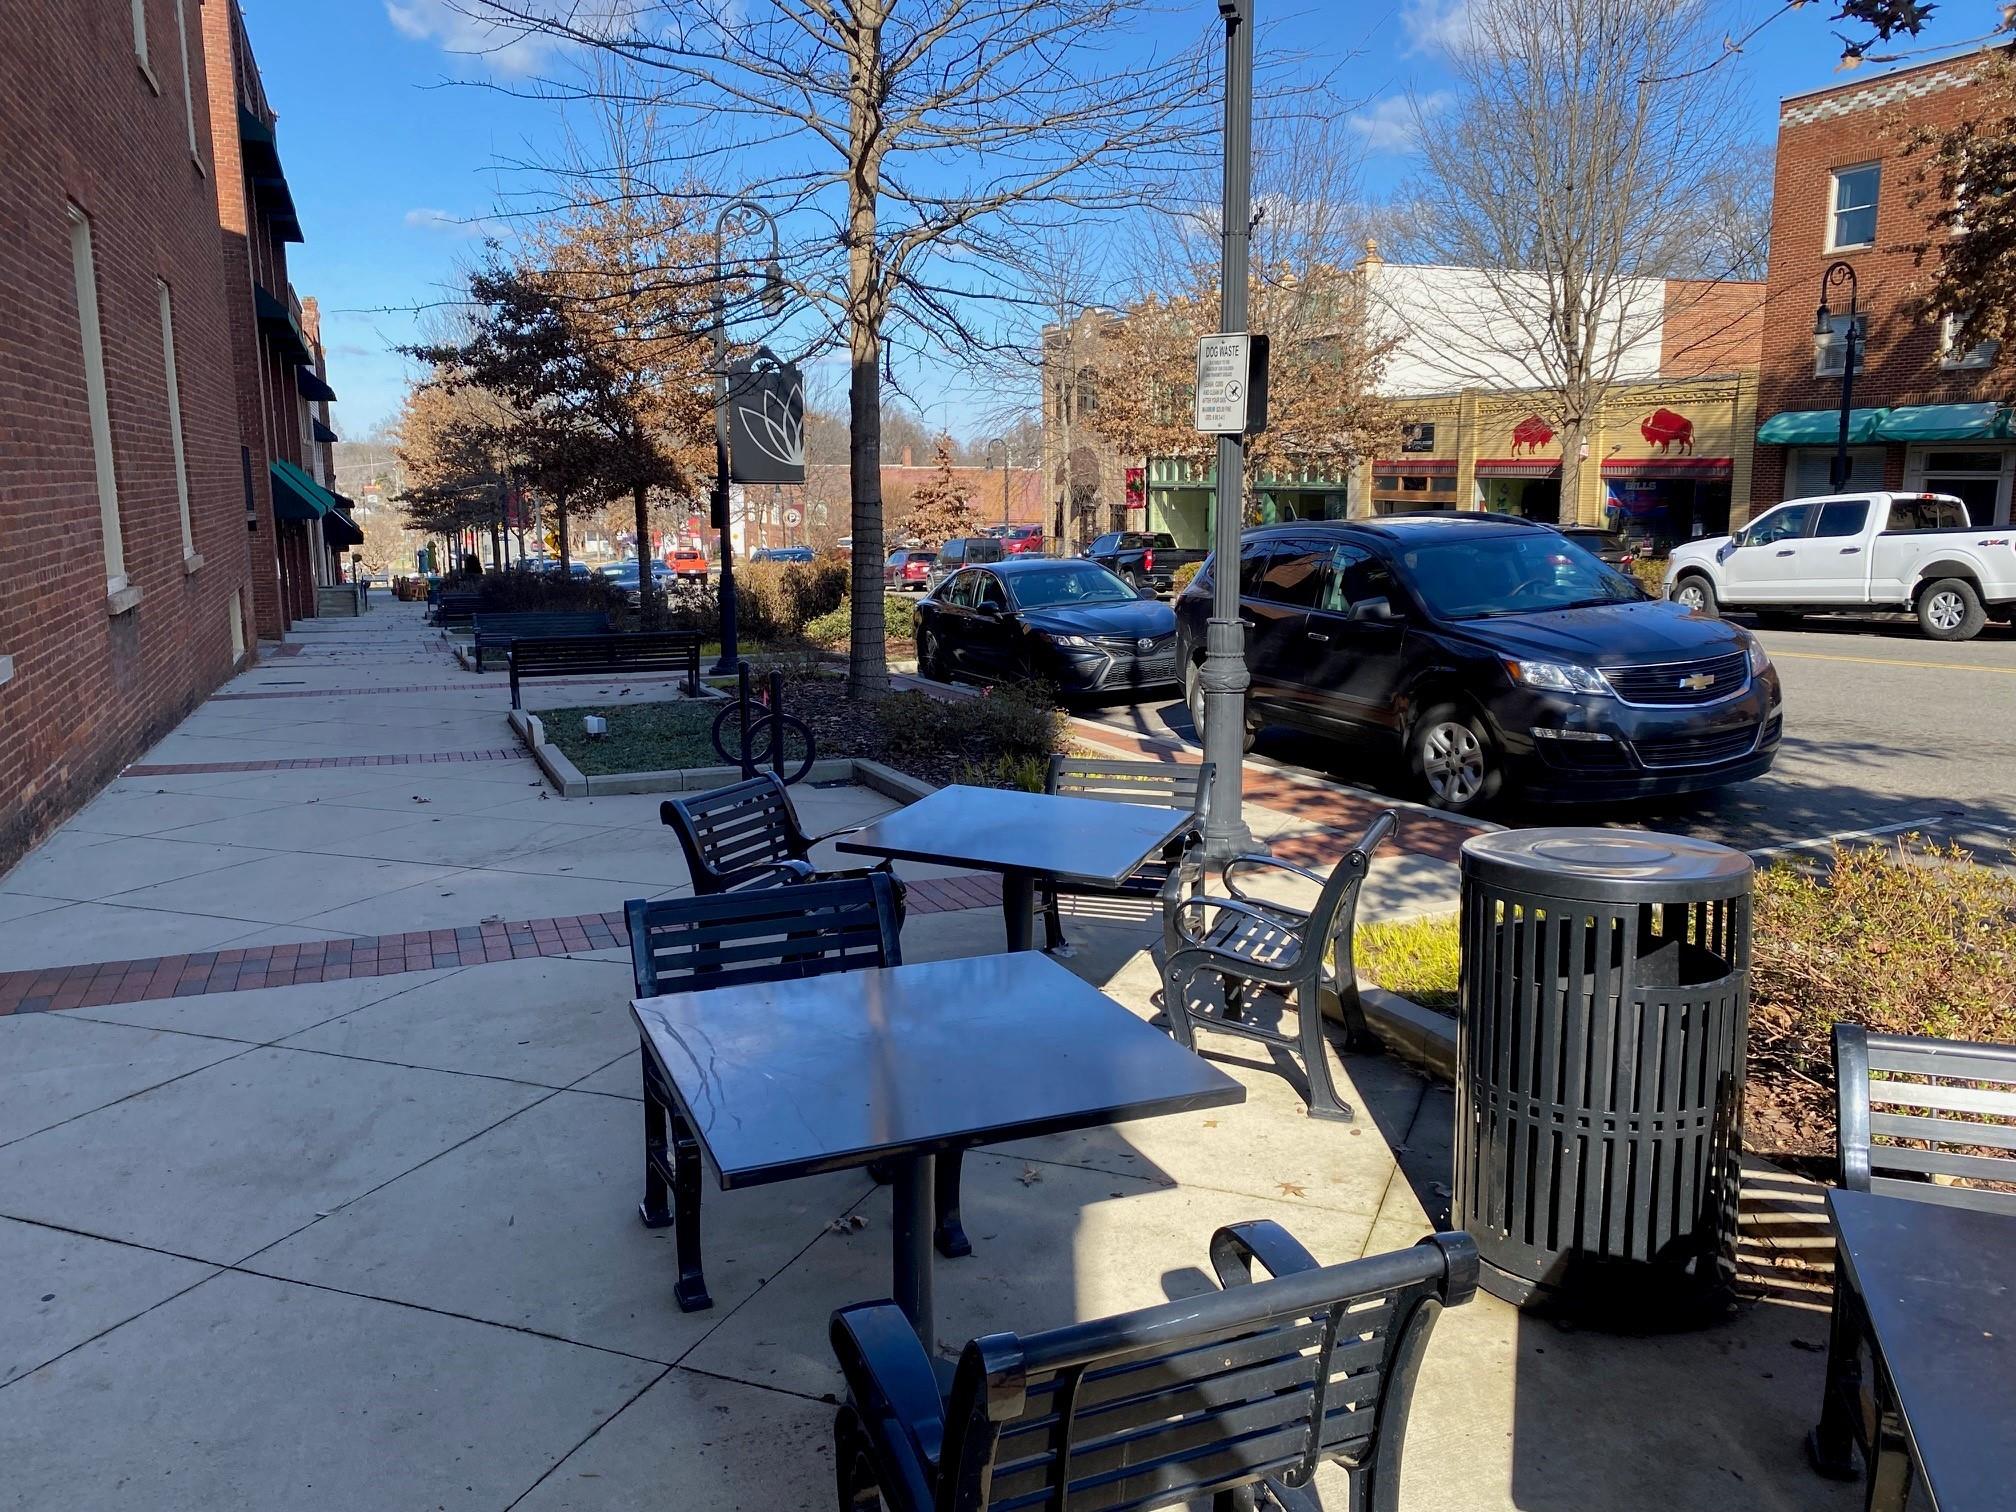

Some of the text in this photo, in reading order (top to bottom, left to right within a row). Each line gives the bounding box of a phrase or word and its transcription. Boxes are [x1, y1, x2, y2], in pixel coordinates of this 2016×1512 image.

[1206, 345, 1239, 358] DOG WASTE
[1624, 482, 1657, 490] BILLS
